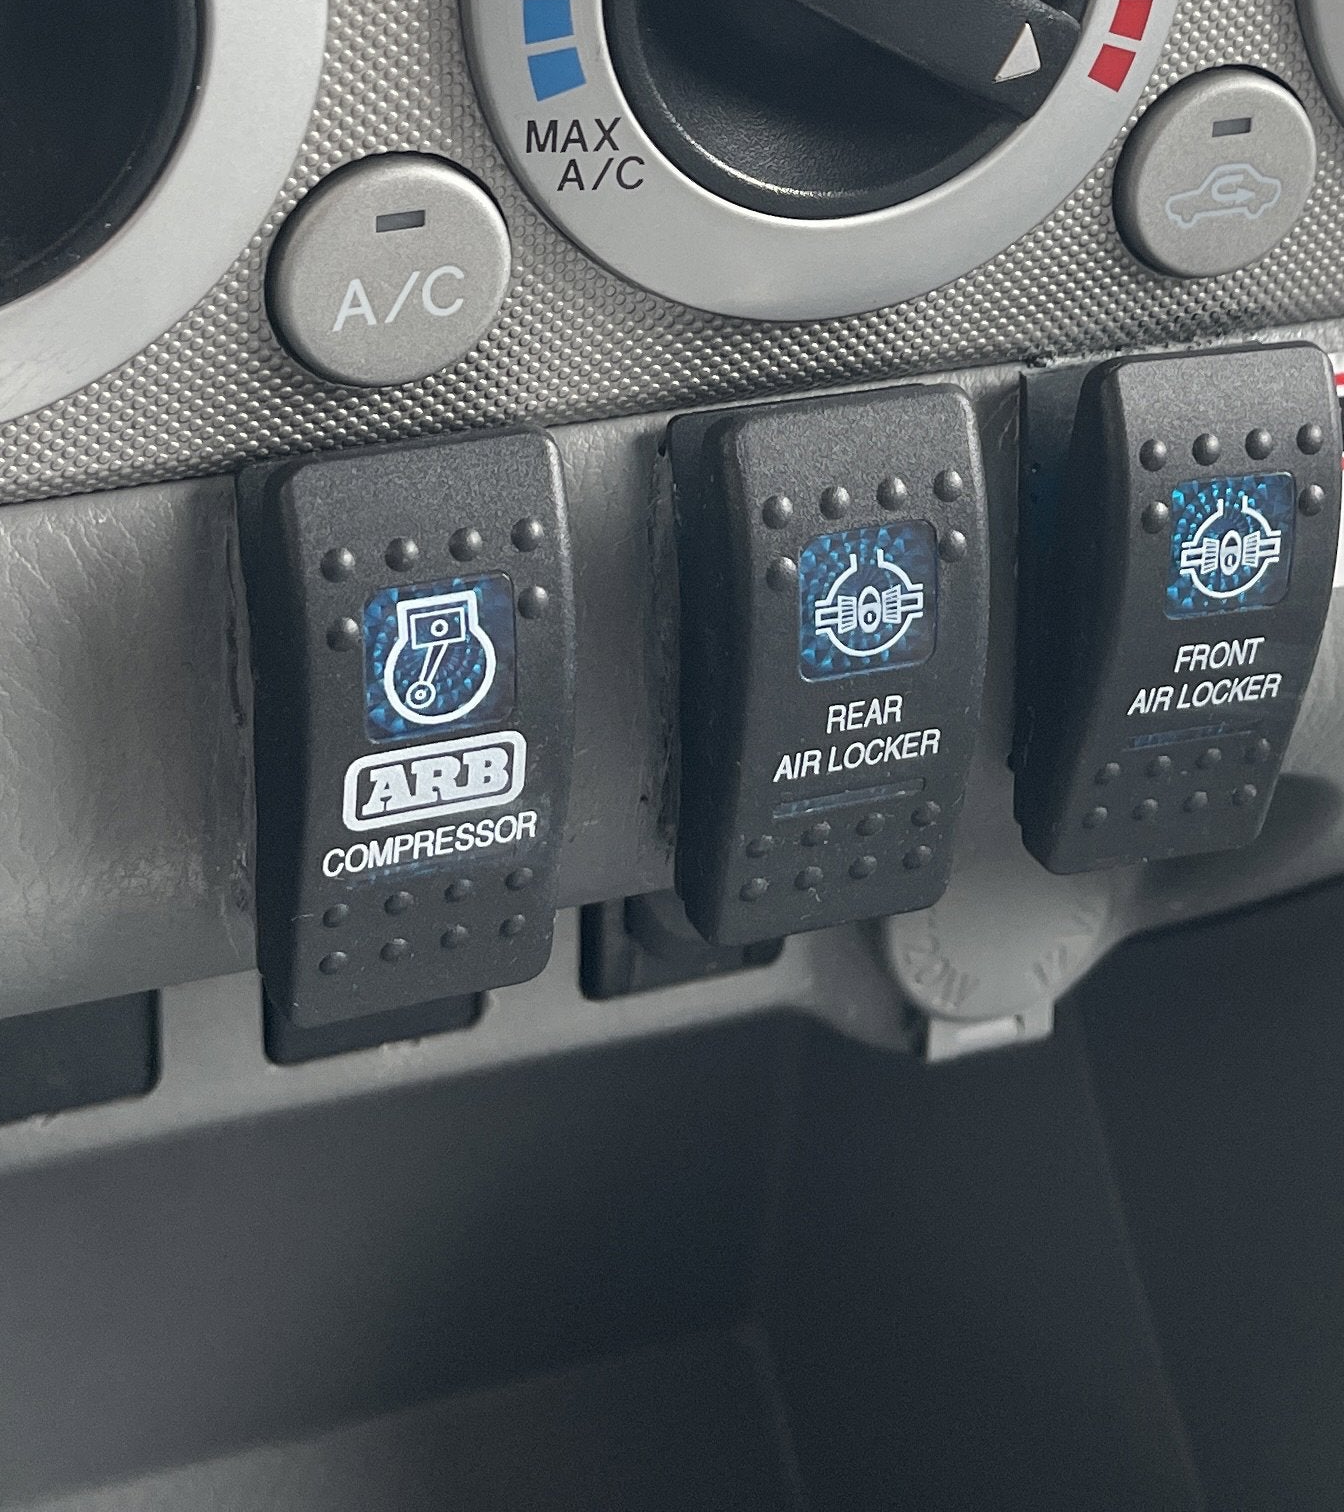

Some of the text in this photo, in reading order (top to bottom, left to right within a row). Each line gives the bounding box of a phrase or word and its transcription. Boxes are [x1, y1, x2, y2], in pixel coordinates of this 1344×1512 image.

[525, 116, 620, 154] MAX
[557, 153, 646, 193] A/C
[332, 265, 466, 332] A/C
[1173, 636, 1266, 674] FRONT
[826, 694, 904, 735] REAR
[1126, 672, 1283, 716] AIR LOCKER
[772, 728, 942, 783] AIR LOCKER
[361, 745, 510, 818] ARB
[321, 809, 539, 878] COMPRESSOR
